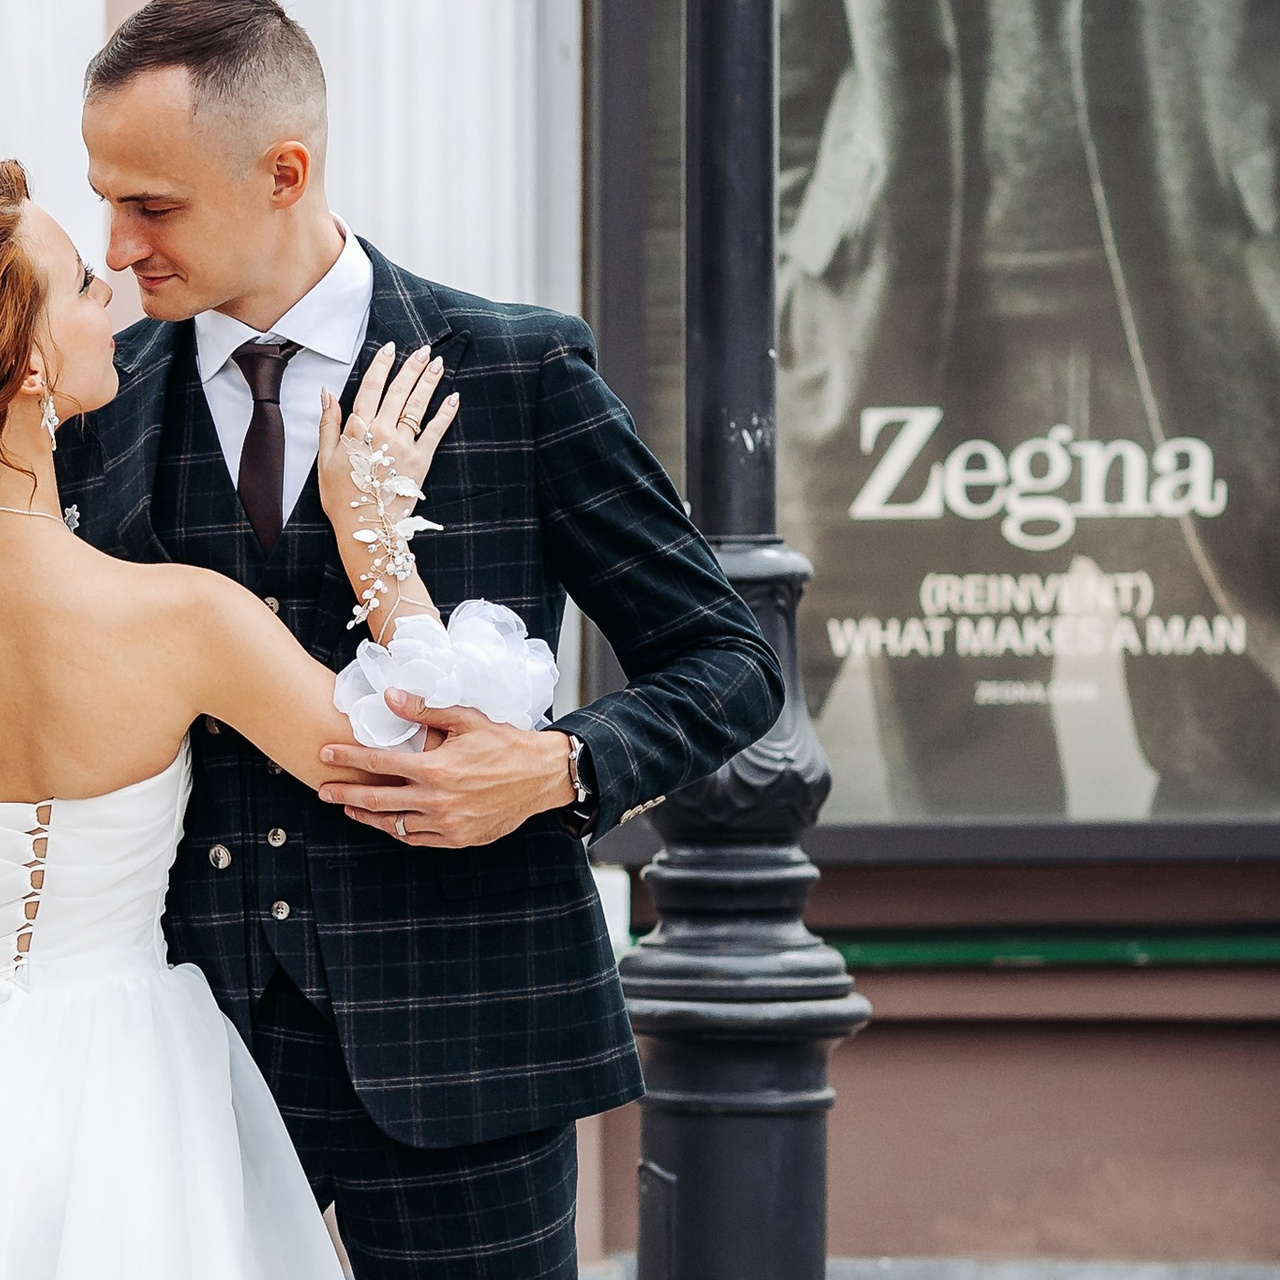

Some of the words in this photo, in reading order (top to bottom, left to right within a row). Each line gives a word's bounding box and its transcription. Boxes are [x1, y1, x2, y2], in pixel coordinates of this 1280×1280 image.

[849, 406, 1228, 551] Zegna
[827, 617, 953, 657] WHAT
[956, 617, 1105, 657] MAKES
[1111, 617, 1143, 656] A
[1146, 615, 1247, 656] MAN
